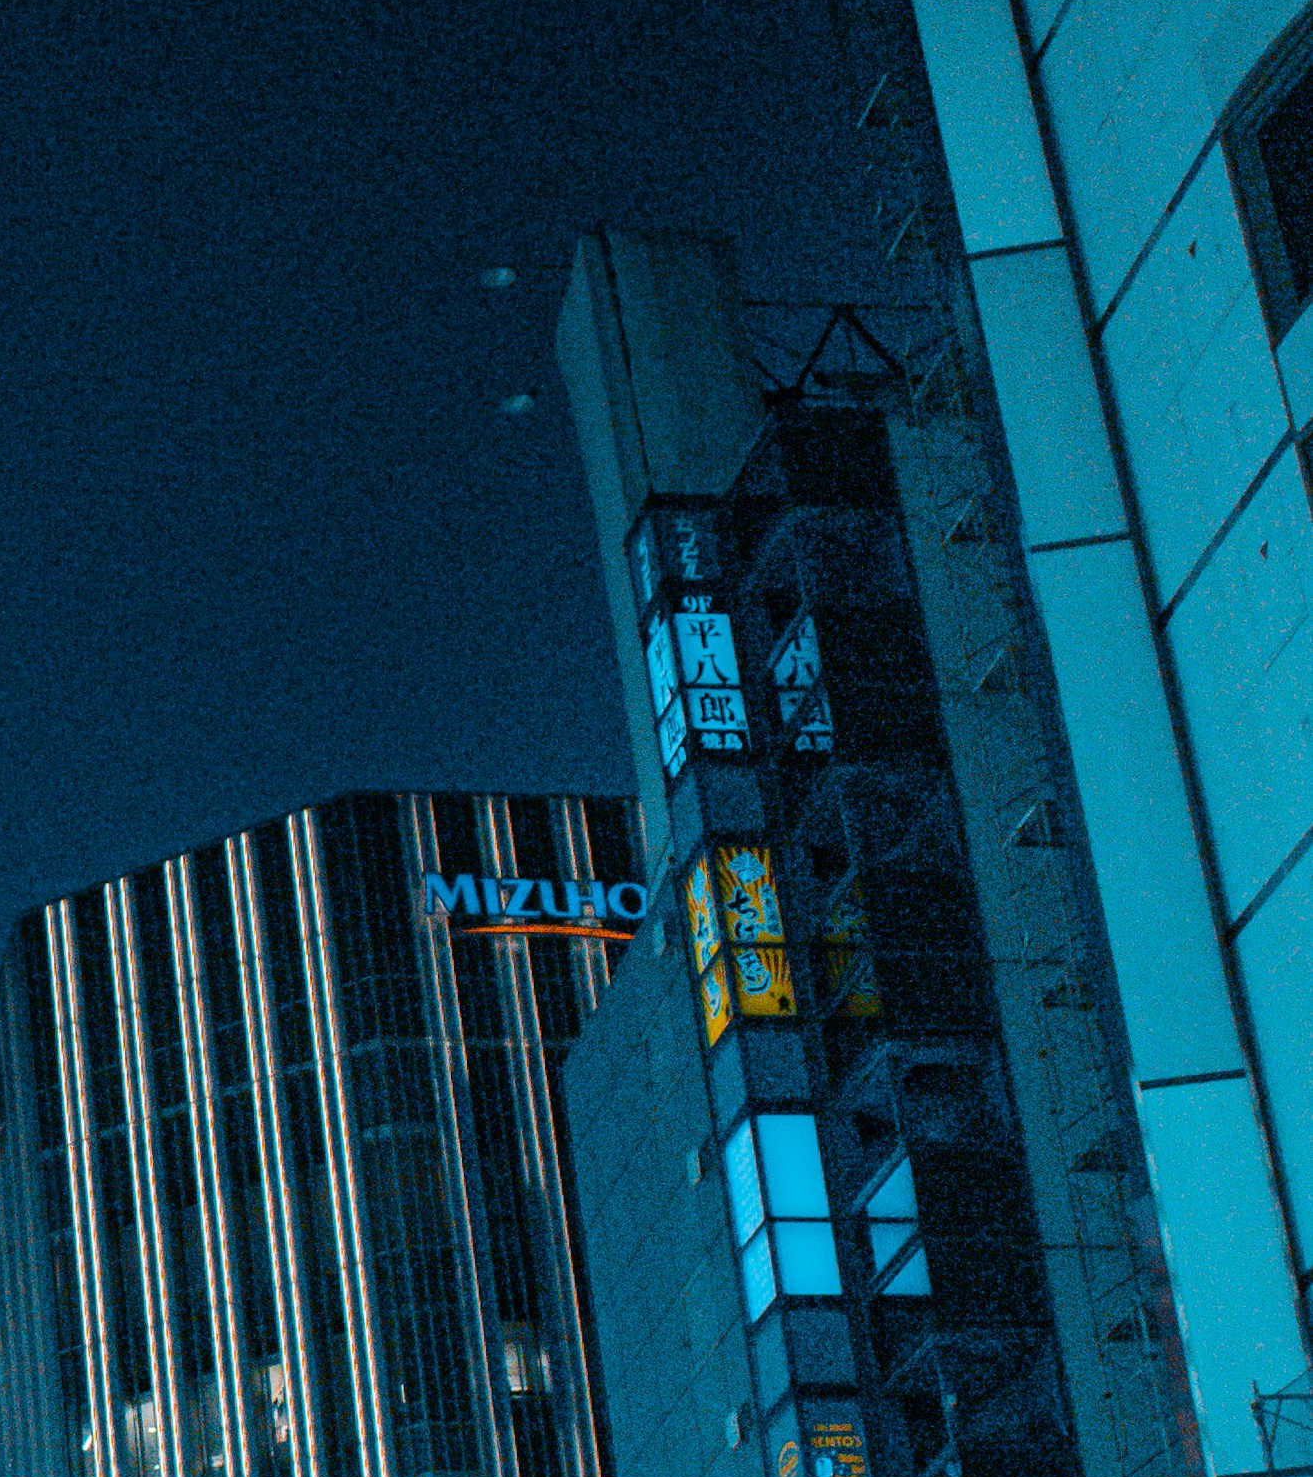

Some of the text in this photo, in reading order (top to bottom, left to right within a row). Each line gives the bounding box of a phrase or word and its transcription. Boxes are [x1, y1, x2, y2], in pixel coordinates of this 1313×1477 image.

[685, 618, 740, 728] 平八郎
[425, 872, 649, 920] MIZUHO
